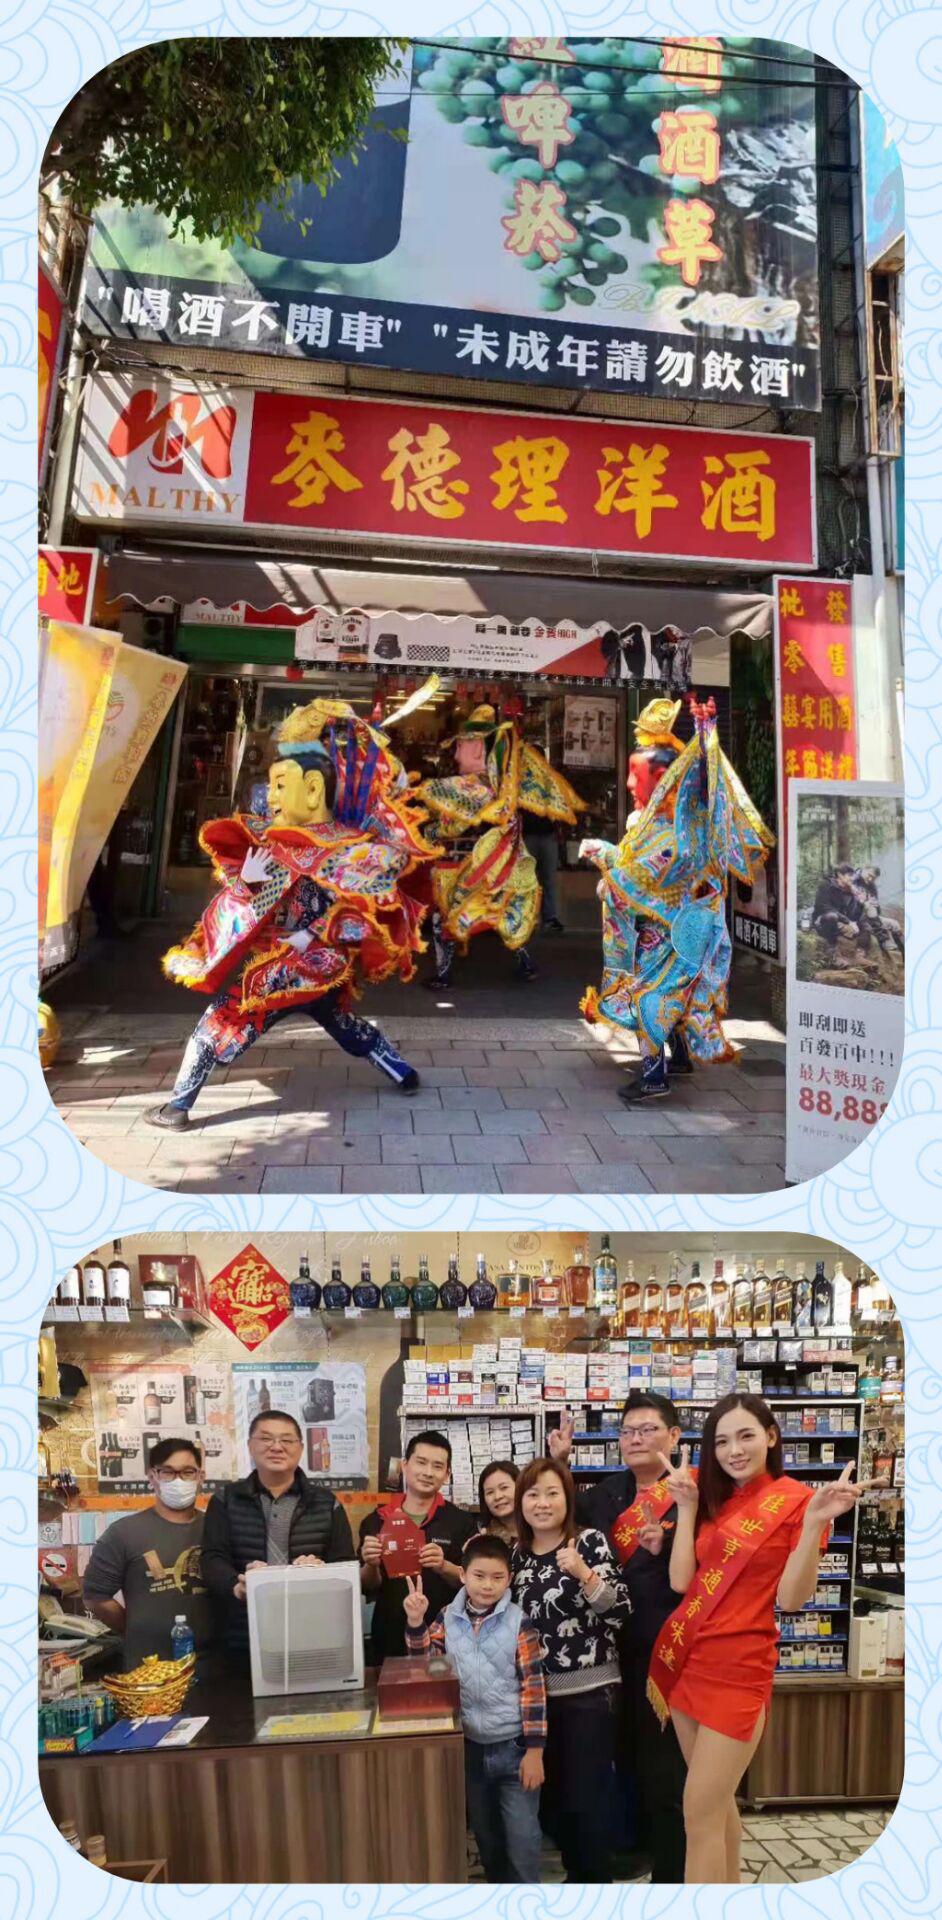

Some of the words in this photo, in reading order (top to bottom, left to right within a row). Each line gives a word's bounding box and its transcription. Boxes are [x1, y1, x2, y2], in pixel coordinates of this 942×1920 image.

[270, 410, 777, 542] 麥德理洋酒
[90, 481, 244, 513] MALTHY
[799, 1011, 867, 1038] 即刮即送
